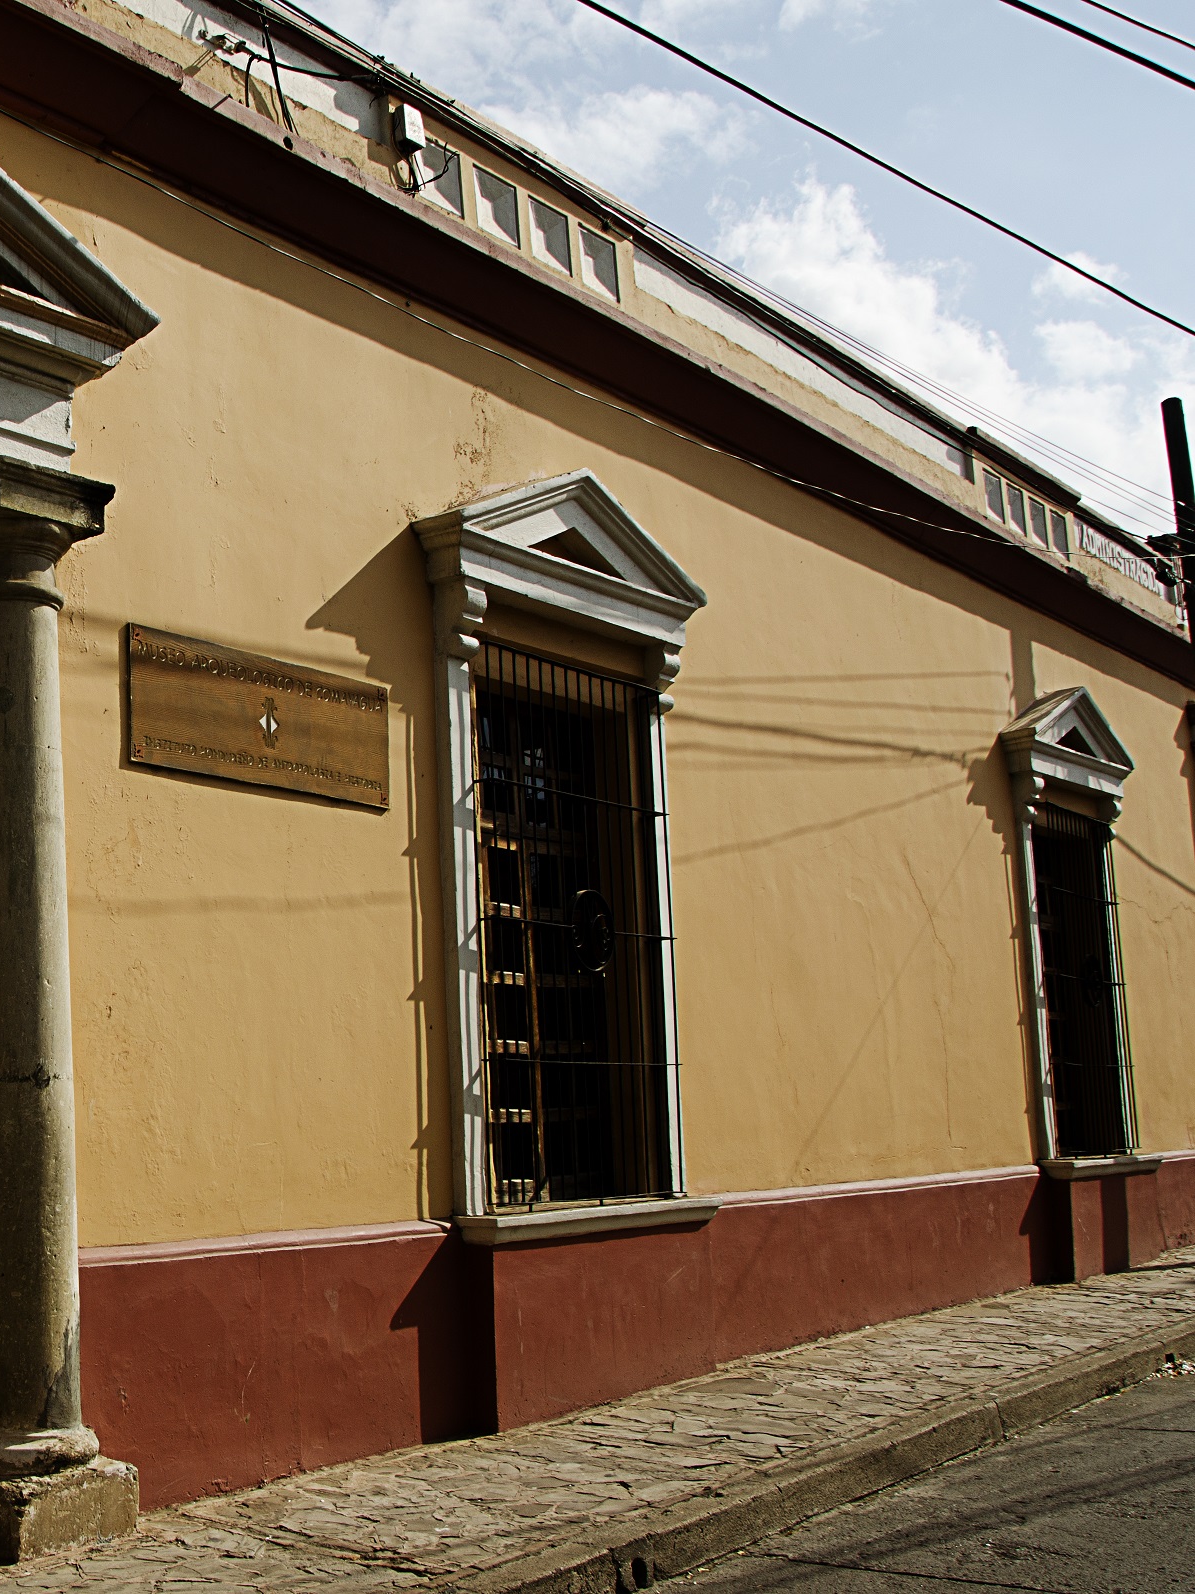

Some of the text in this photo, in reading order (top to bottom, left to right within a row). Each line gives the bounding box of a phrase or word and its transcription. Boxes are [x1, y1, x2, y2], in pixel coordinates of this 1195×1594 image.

[138, 642, 383, 712] MUSEO ARQUEOLOGICO DE COMAYAGUA
[143, 735, 197, 756] INSTITUTO
[258, 756, 269, 769] DE
